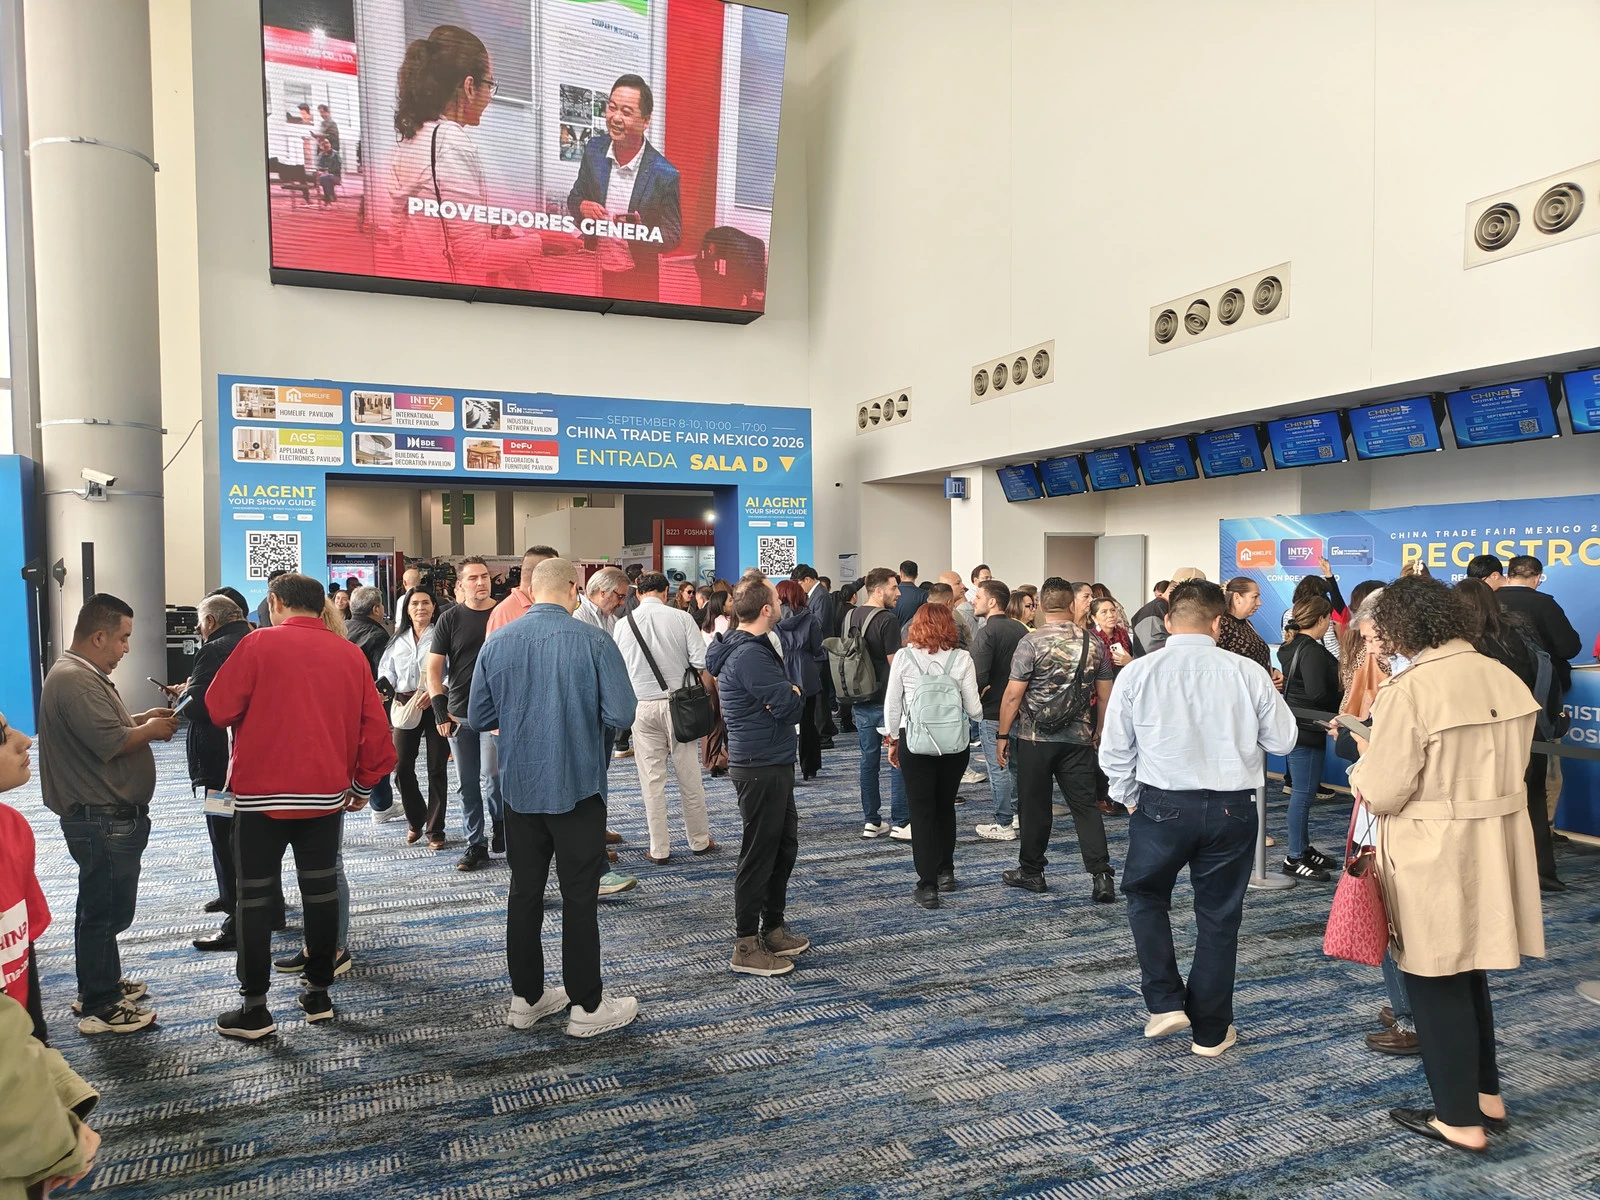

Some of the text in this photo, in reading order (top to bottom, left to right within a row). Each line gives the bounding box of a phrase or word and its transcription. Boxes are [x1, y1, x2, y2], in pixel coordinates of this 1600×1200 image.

[408, 197, 664, 243] PROVEEDORES GENERA
[410, 396, 443, 410] INTEX
[280, 409, 334, 418] HOMELIFE PAVILION
[396, 411, 434, 419] INTERNATIONAL
[1486, 411, 1516, 419] SEPTEMBER
[396, 418, 439, 427] TEXTILE PAVILION
[606, 415, 676, 429] SEPTEMBER
[678, 419, 703, 431] 8-10,
[705, 421, 732, 431] 10:00
[742, 422, 767, 433] 17:00
[420, 439, 435, 447] BDE
[566, 426, 805, 449] CHINA TRADE FAIR MEXICO 2026
[279, 447, 308, 455] APPLIANCE
[279, 454, 315, 462] ELECTRONICS
[576, 449, 768, 473] ENTRADA SALA D
[229, 484, 316, 498] AI AGENT
[257, 498, 286, 506] SHOW
[745, 497, 808, 508] AI AGENT
[1390, 530, 1428, 540] CHINA
[1435, 529, 1477, 538] TRADE
[1486, 527, 1516, 536] FAIR
[1525, 524, 1581, 535] MEXICO
[1288, 547, 1314, 560] INTEX
